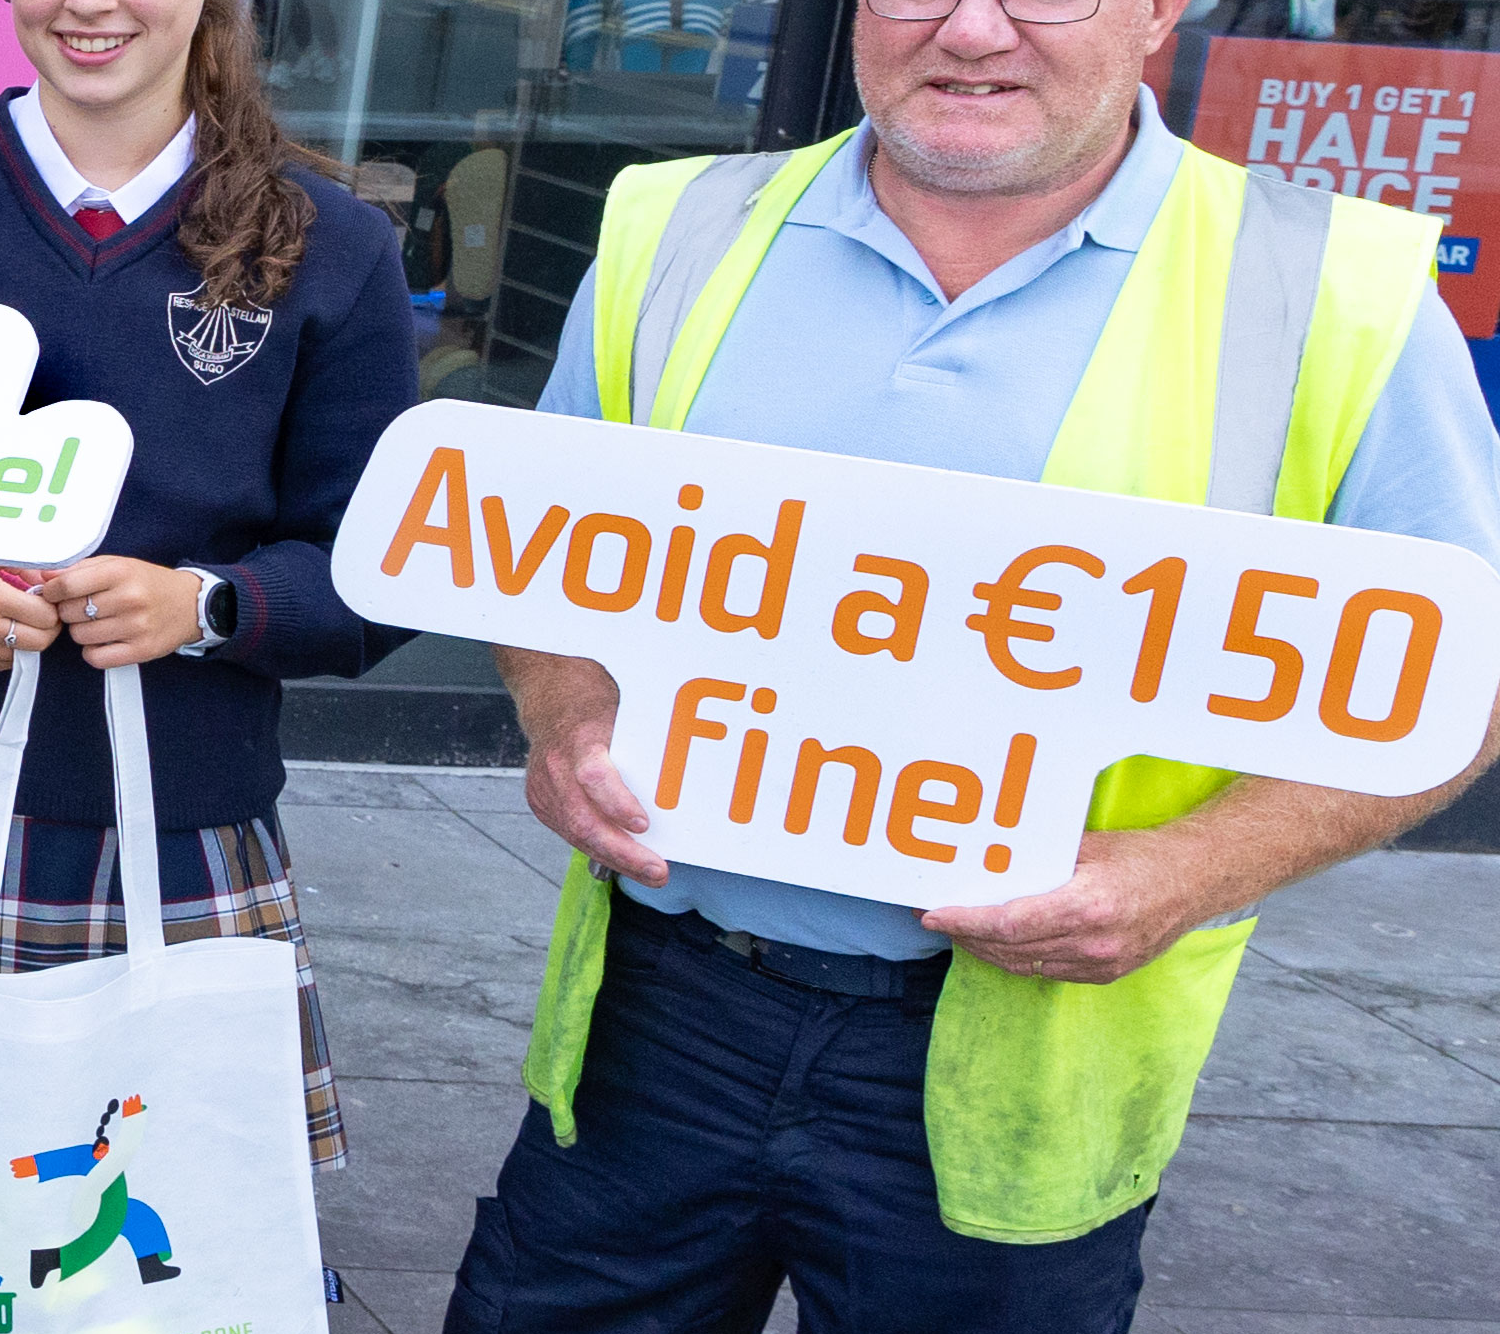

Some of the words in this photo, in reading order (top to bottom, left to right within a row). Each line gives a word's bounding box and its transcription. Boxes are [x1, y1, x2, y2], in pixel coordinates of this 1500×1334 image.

[1259, 78, 1337, 108] BUY
[1346, 84, 1363, 110] 1
[1374, 86, 1450, 115] GET
[1459, 91, 1476, 117] 1
[1247, 107, 1470, 173] HALF
[1435, 244, 1470, 266] AR
[193, 360, 224, 374] SLIGO
[380, 446, 807, 640] Avoid
[830, 551, 929, 663] a
[964, 543, 1444, 744] €150
